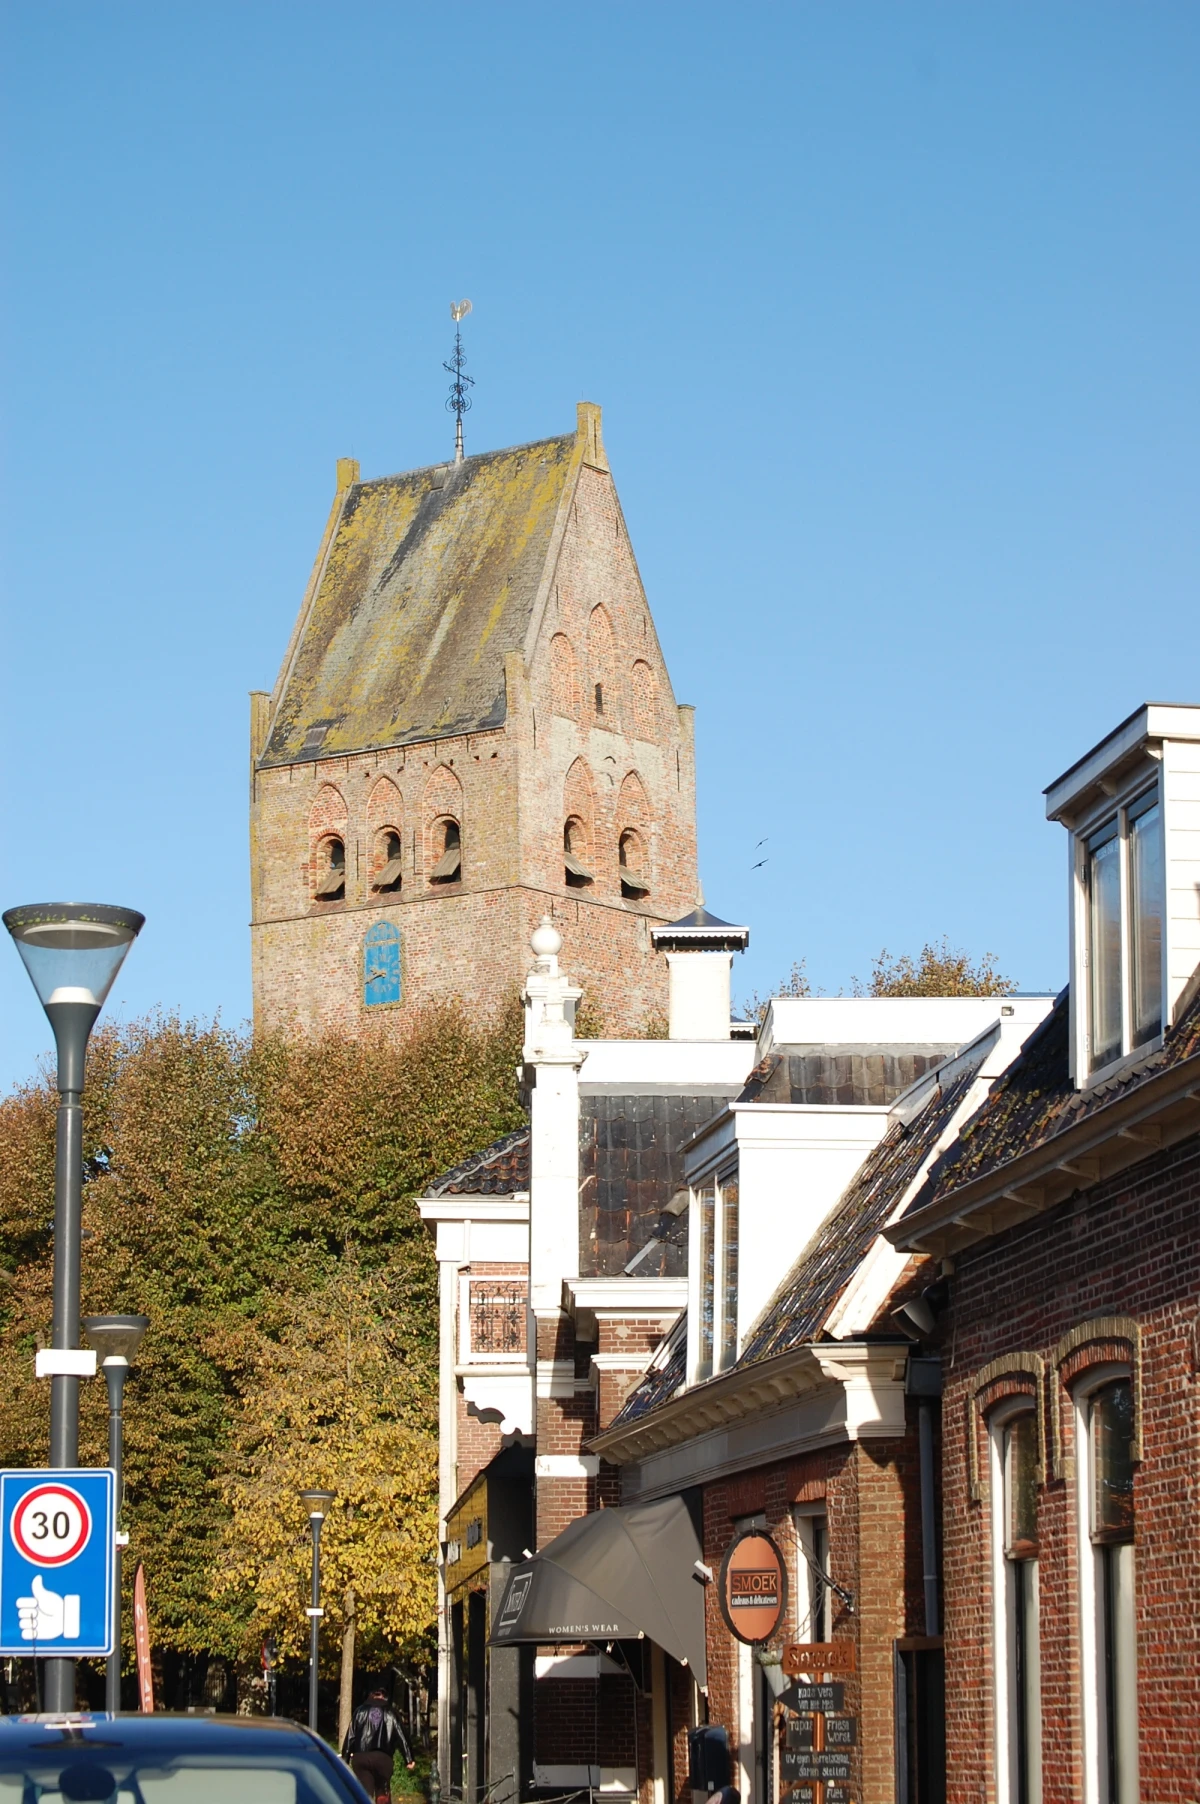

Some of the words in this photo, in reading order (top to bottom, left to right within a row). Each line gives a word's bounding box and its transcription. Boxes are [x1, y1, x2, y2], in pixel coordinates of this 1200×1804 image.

[31, 1510, 70, 1539] 30
[732, 1575, 777, 1591] SMOEK
[548, 1625, 589, 1634] WOMEN'S
[592, 1624, 619, 1632] WEAR
